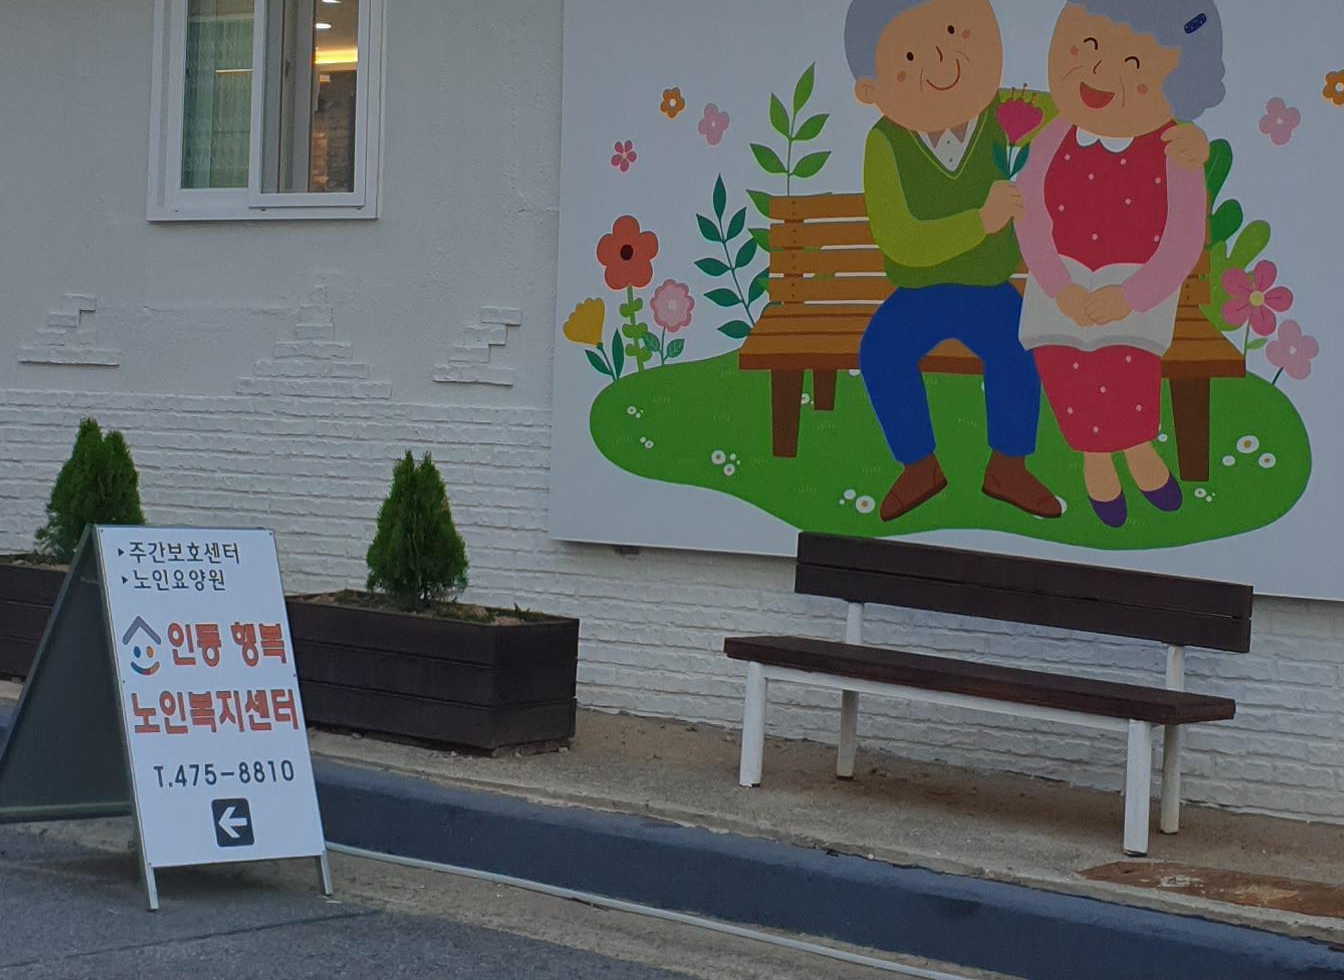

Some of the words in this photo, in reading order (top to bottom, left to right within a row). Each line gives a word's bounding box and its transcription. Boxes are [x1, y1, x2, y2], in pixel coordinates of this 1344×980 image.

[129, 541, 240, 565] 주간보호센터
[133, 569, 226, 592] 노인요양원
[167, 622, 222, 667] 인동
[230, 621, 288, 667] 행복
[131, 688, 300, 734] 노인복지센터
[153, 759, 295, 788] T.475-8810
